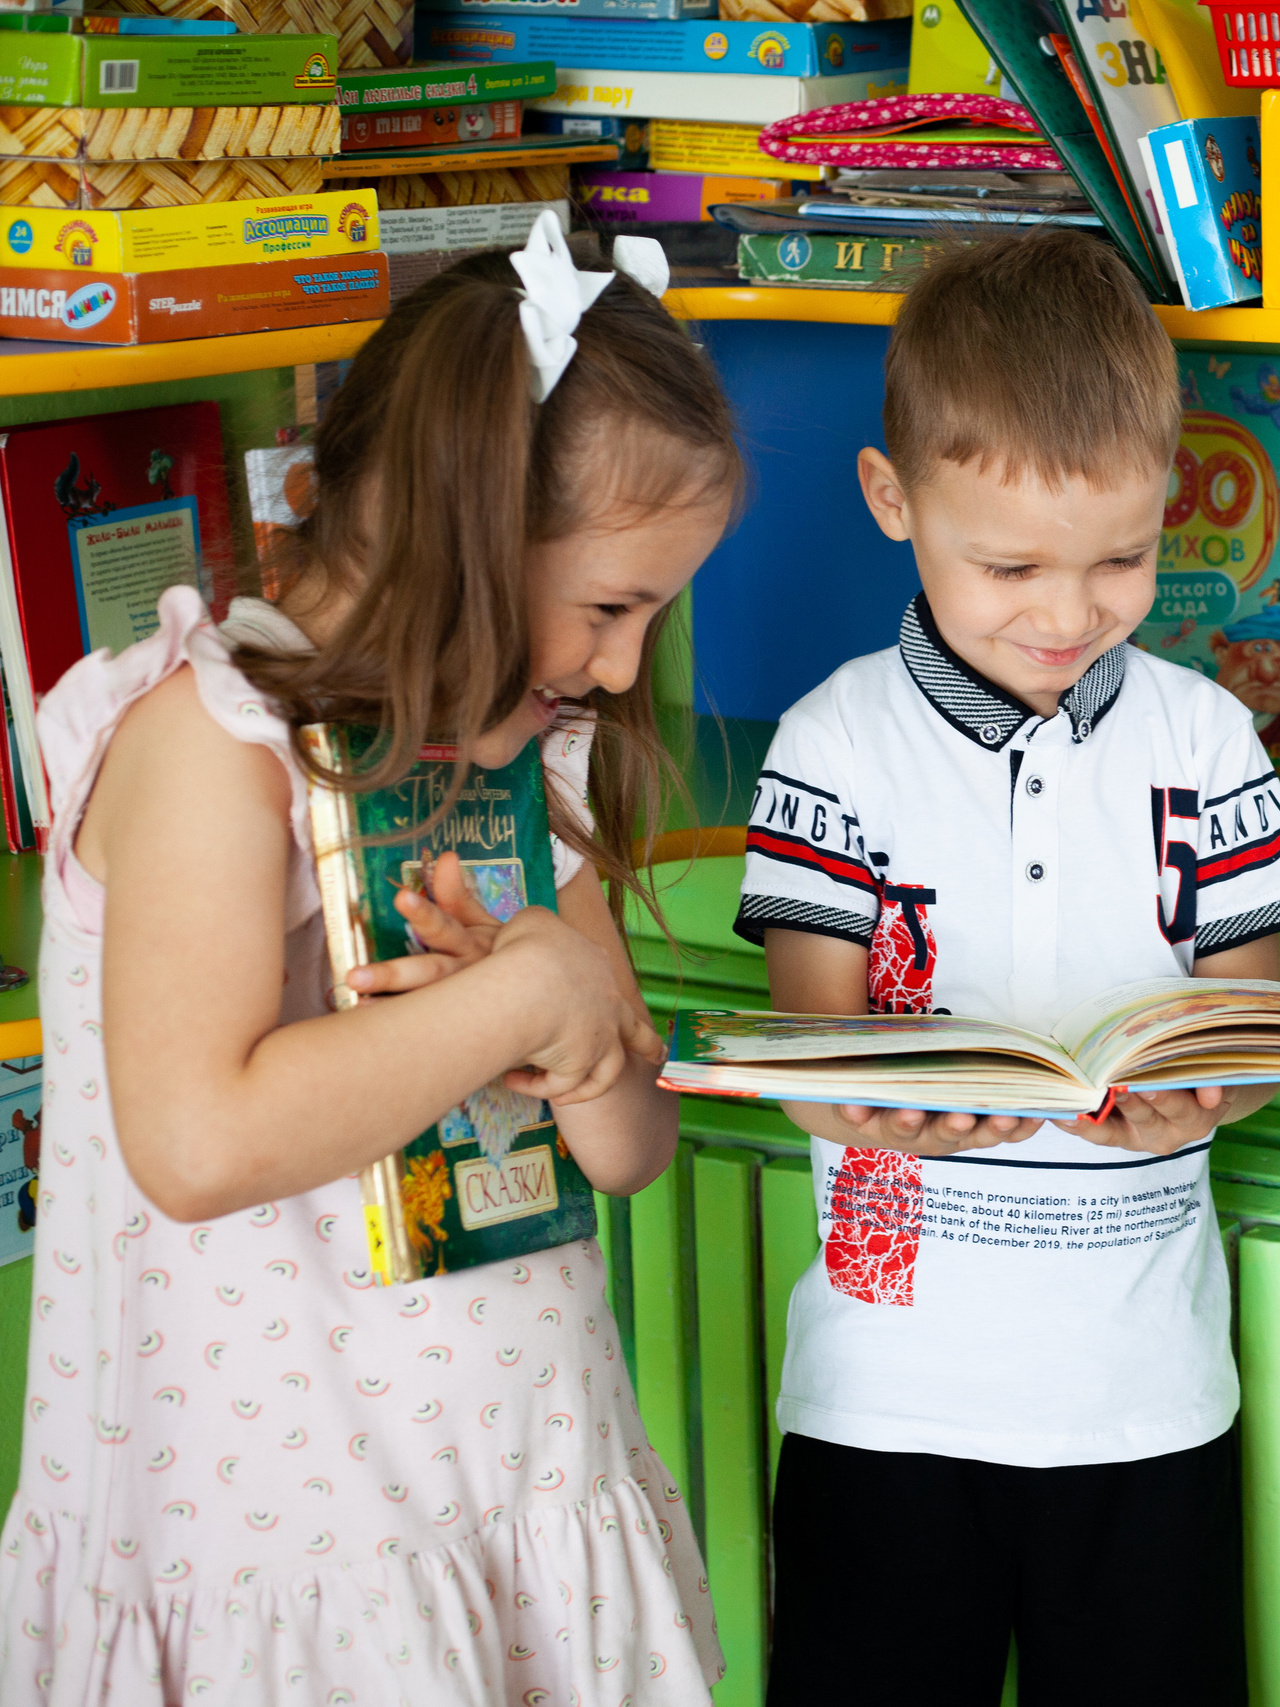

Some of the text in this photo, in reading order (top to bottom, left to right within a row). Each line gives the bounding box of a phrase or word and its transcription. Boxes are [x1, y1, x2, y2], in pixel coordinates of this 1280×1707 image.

[467, 73, 477, 95] 4
[593, 86, 634, 108] пару
[15, 225, 27, 238] 24
[246, 216, 328, 242] Ассоциации
[263, 241, 311, 253] Профессии
[294, 274, 311, 285] ЧТО
[312, 272, 339, 284] ТАКОЕ
[302, 285, 320, 295] ЧТО
[322, 283, 347, 293] ТАКОЕ
[0, 286, 67, 319] ИМСЯ
[150, 297, 175, 310] STEP
[170, 299, 202, 314] puzzle
[1161, 534, 1245, 567] ИХОВ
[1161, 601, 1208, 617] САДА
[465, 1162, 550, 1213] СКАЗКИ
[942, 1186, 983, 1200] (French
[987, 1193, 1071, 1206] pronunciation:
[1077, 1196, 1087, 1206] is
[1090, 1198, 1097, 1206] a
[1100, 1195, 1119, 1207] city
[1122, 1194, 1130, 1204] in
[1132, 1190, 1162, 1202] eastern
[826, 1180, 866, 1200] Canadian
[868, 1190, 910, 1205] province
[913, 1196, 924, 1206] of
[926, 1198, 968, 1214] Quebec,
[972, 1205, 1004, 1218] about
[1007, 1209, 1021, 1219] 40
[1024, 1210, 1083, 1221] kilometres
[1086, 1210, 1103, 1222] (25
[1106, 1209, 1122, 1220] mi)
[1125, 1201, 1168, 1217] southeast
[1169, 1199, 1177, 1210] of
[839, 1197, 877, 1214] situated
[879, 1206, 891, 1216] on
[894, 1208, 910, 1219] the
[913, 1211, 938, 1223] west
[940, 1214, 966, 1227] bank
[969, 1219, 981, 1229] of
[983, 1220, 1000, 1231] the
[1004, 1222, 1057, 1235] Richelieu
[1061, 1226, 1090, 1235] River
[1093, 1225, 1103, 1235] at
[1106, 1222, 1122, 1233] the
[822, 1211, 844, 1224] point
[846, 1214, 855, 1224] of
[858, 1216, 880, 1229] Lake
[883, 1220, 938, 1238] Champlain.
[941, 1229, 955, 1241] As
[958, 1233, 970, 1242] of
[972, 1233, 1030, 1248] December
[1067, 1240, 1084, 1250] the
[1087, 1235, 1142, 1250] population
[1143, 1232, 1153, 1243] of
